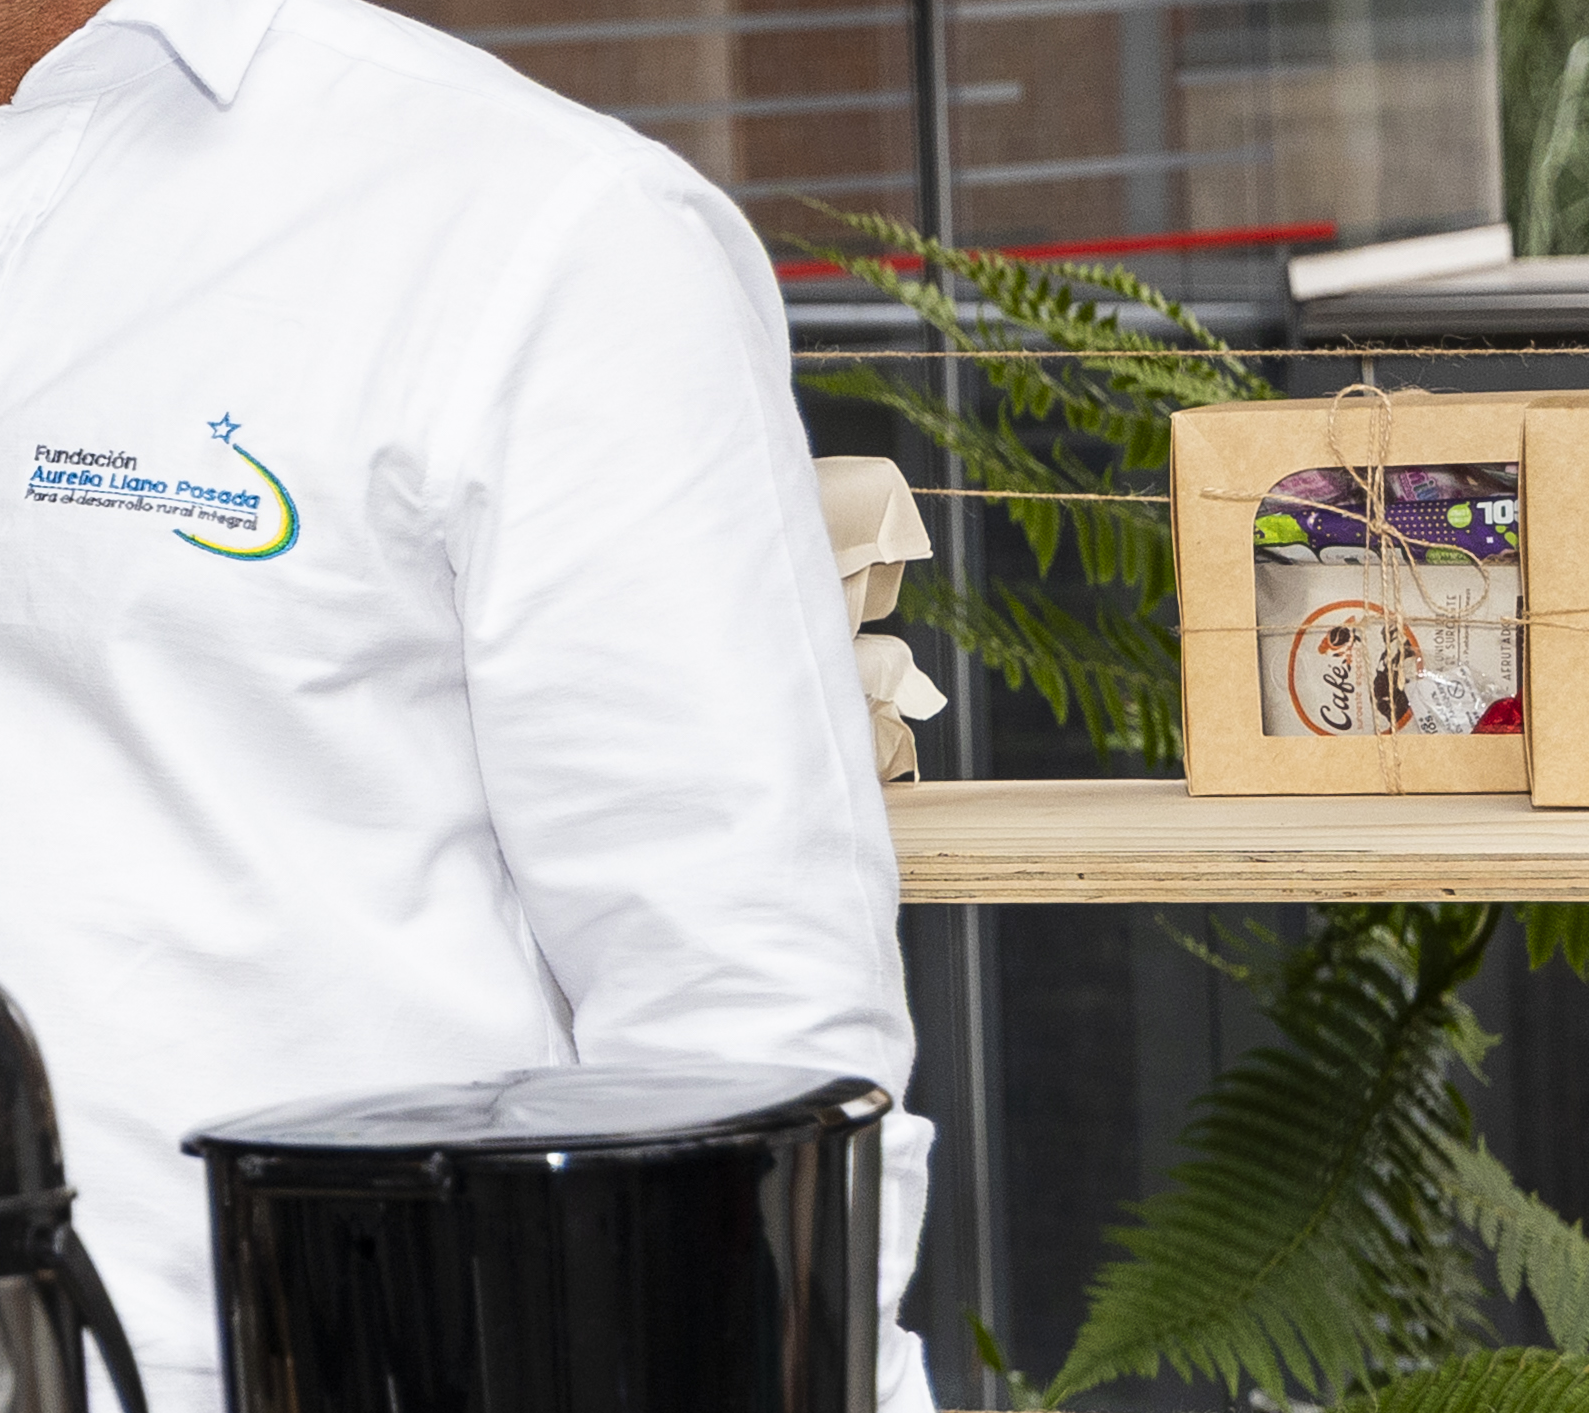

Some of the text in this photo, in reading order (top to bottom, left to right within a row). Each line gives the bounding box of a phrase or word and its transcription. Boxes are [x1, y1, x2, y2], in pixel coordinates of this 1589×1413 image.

[34, 444, 137, 472] Fundación
[29, 464, 261, 510] Aurelio Llano Posada
[25, 488, 57, 504] Para
[75, 490, 153, 513] desarrollo
[156, 502, 194, 519] rural
[198, 506, 258, 532] integral
[1320, 663, 1355, 732] Café
